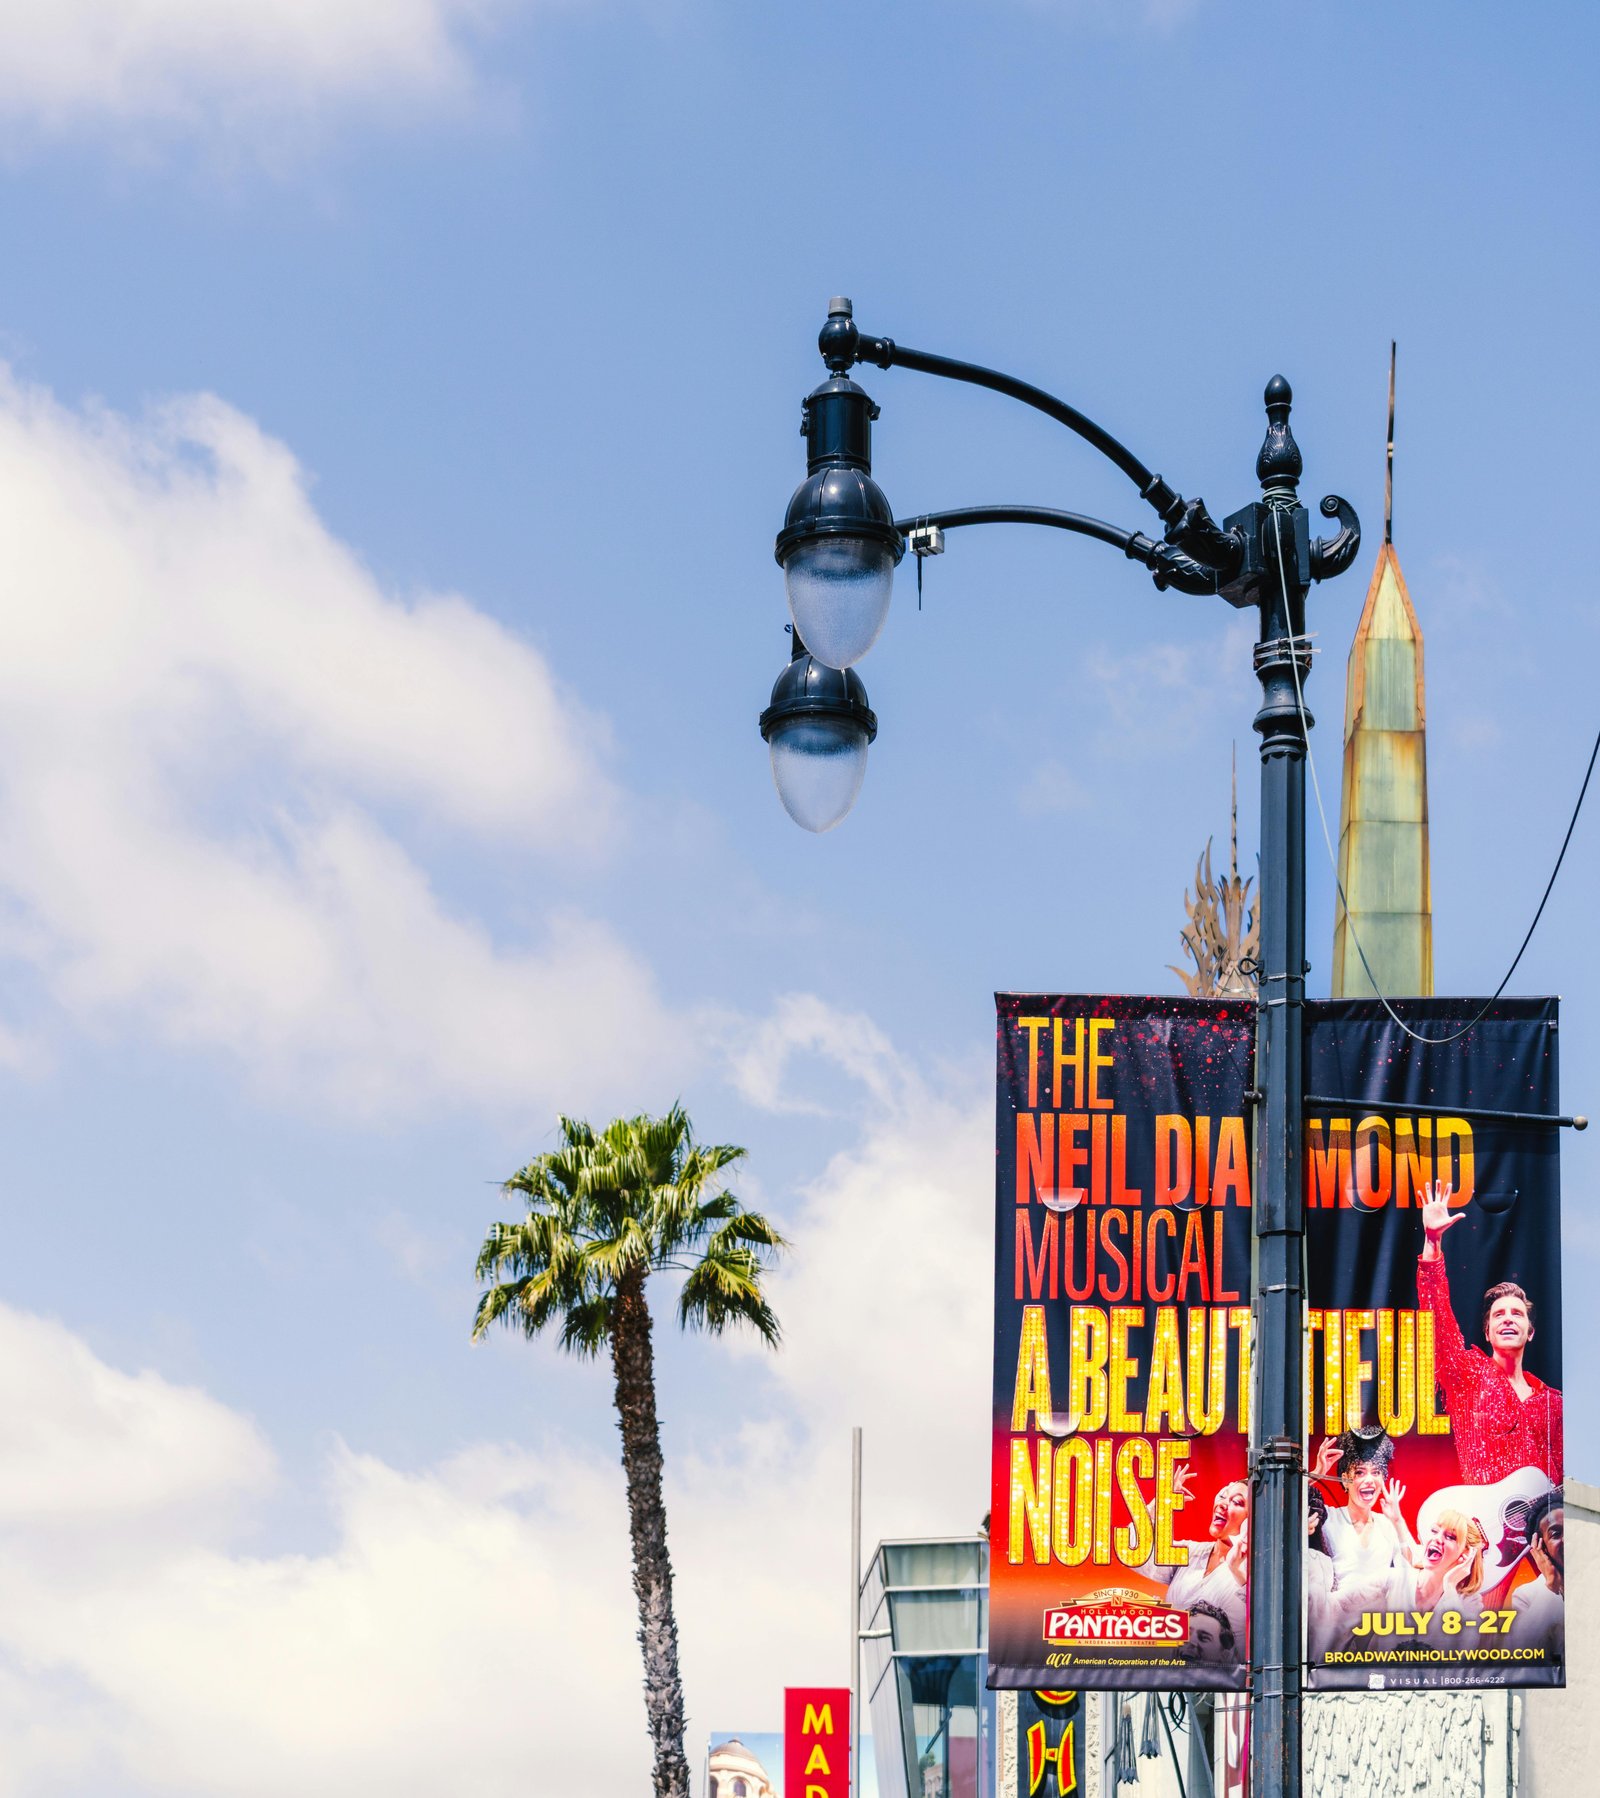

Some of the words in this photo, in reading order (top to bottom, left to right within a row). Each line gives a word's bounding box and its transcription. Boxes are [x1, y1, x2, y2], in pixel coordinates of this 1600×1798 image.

[1018, 1016, 1115, 1109] THE
[1016, 1113, 1141, 1205] NEIL
[1155, 1114, 1474, 1208] DIAMOND
[1014, 1208, 1239, 1302] MUSICAL
[1010, 1304, 1052, 1432] A
[1008, 1437, 1191, 1566] NOISE
[1093, 1590, 1117, 1599] SINCE
[1120, 1590, 1139, 1599] 1930
[1048, 1612, 1184, 1638] PANTAGES
[1352, 1611, 1434, 1636] JULY
[1441, 1610, 1518, 1635] 8-27
[1107, 1658, 1148, 1667] Corporation
[1149, 1658, 1158, 1666] of
[1158, 1658, 1171, 1666] the
[1324, 1648, 1545, 1663] BROADWAYINHOLLYWOOD.COM
[1390, 1677, 1439, 1685] VISUAL
[1444, 1676, 1506, 1685] 800-266-4222
